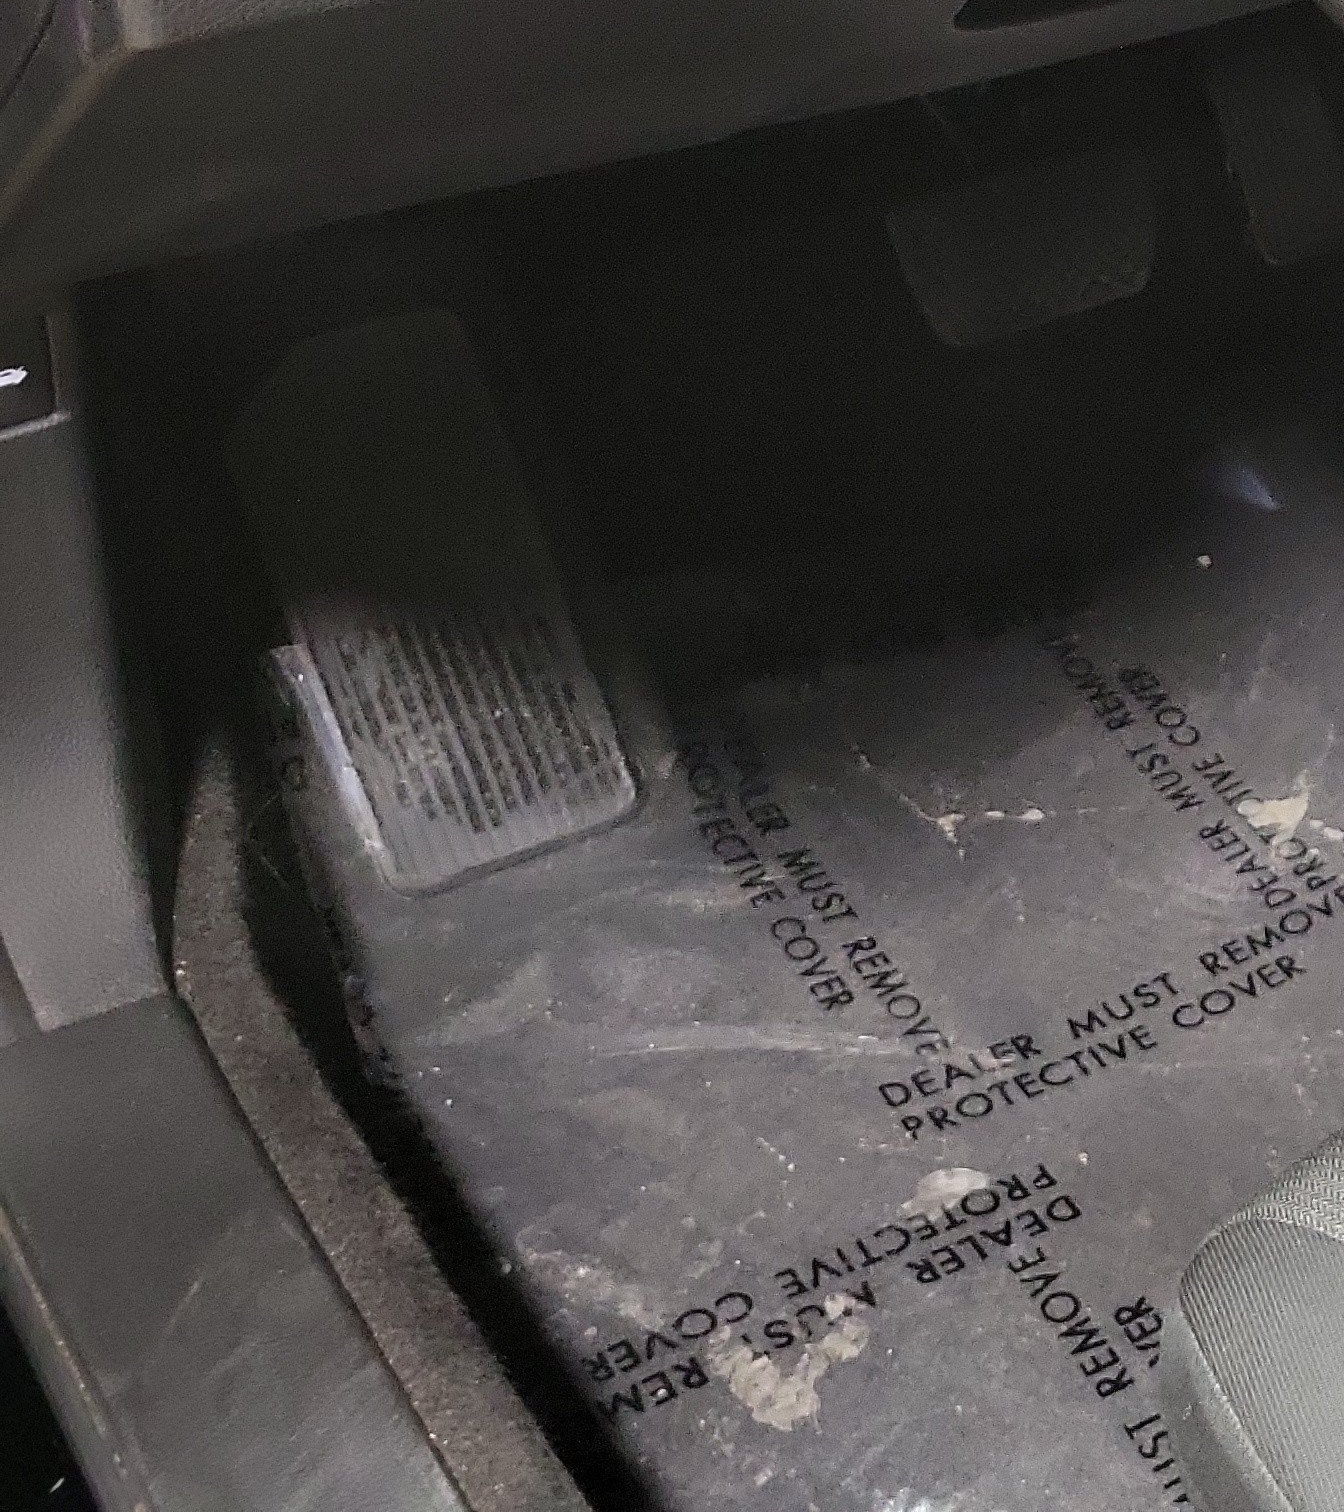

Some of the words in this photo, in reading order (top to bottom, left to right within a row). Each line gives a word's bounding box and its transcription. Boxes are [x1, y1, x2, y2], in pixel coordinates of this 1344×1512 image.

[1117, 664, 1200, 746] COVER
[1126, 743, 1203, 811] MUST
[1200, 819, 1297, 908] DEALER
[770, 916, 855, 1011] COVER
[778, 848, 857, 924] MUST
[842, 936, 949, 1060] REMOVE
[878, 1033, 1042, 1109] DEALER
[1066, 971, 1183, 1040] MUST
[900, 1024, 1159, 1140] PROTECTIVE
[1171, 953, 1308, 1030] COVER
[774, 1163, 1059, 1300] PROTECTIVE
[905, 1193, 1083, 1285] DEALER
[579, 1290, 754, 1382] COVER
[1007, 1246, 1135, 1398] REMOVE
